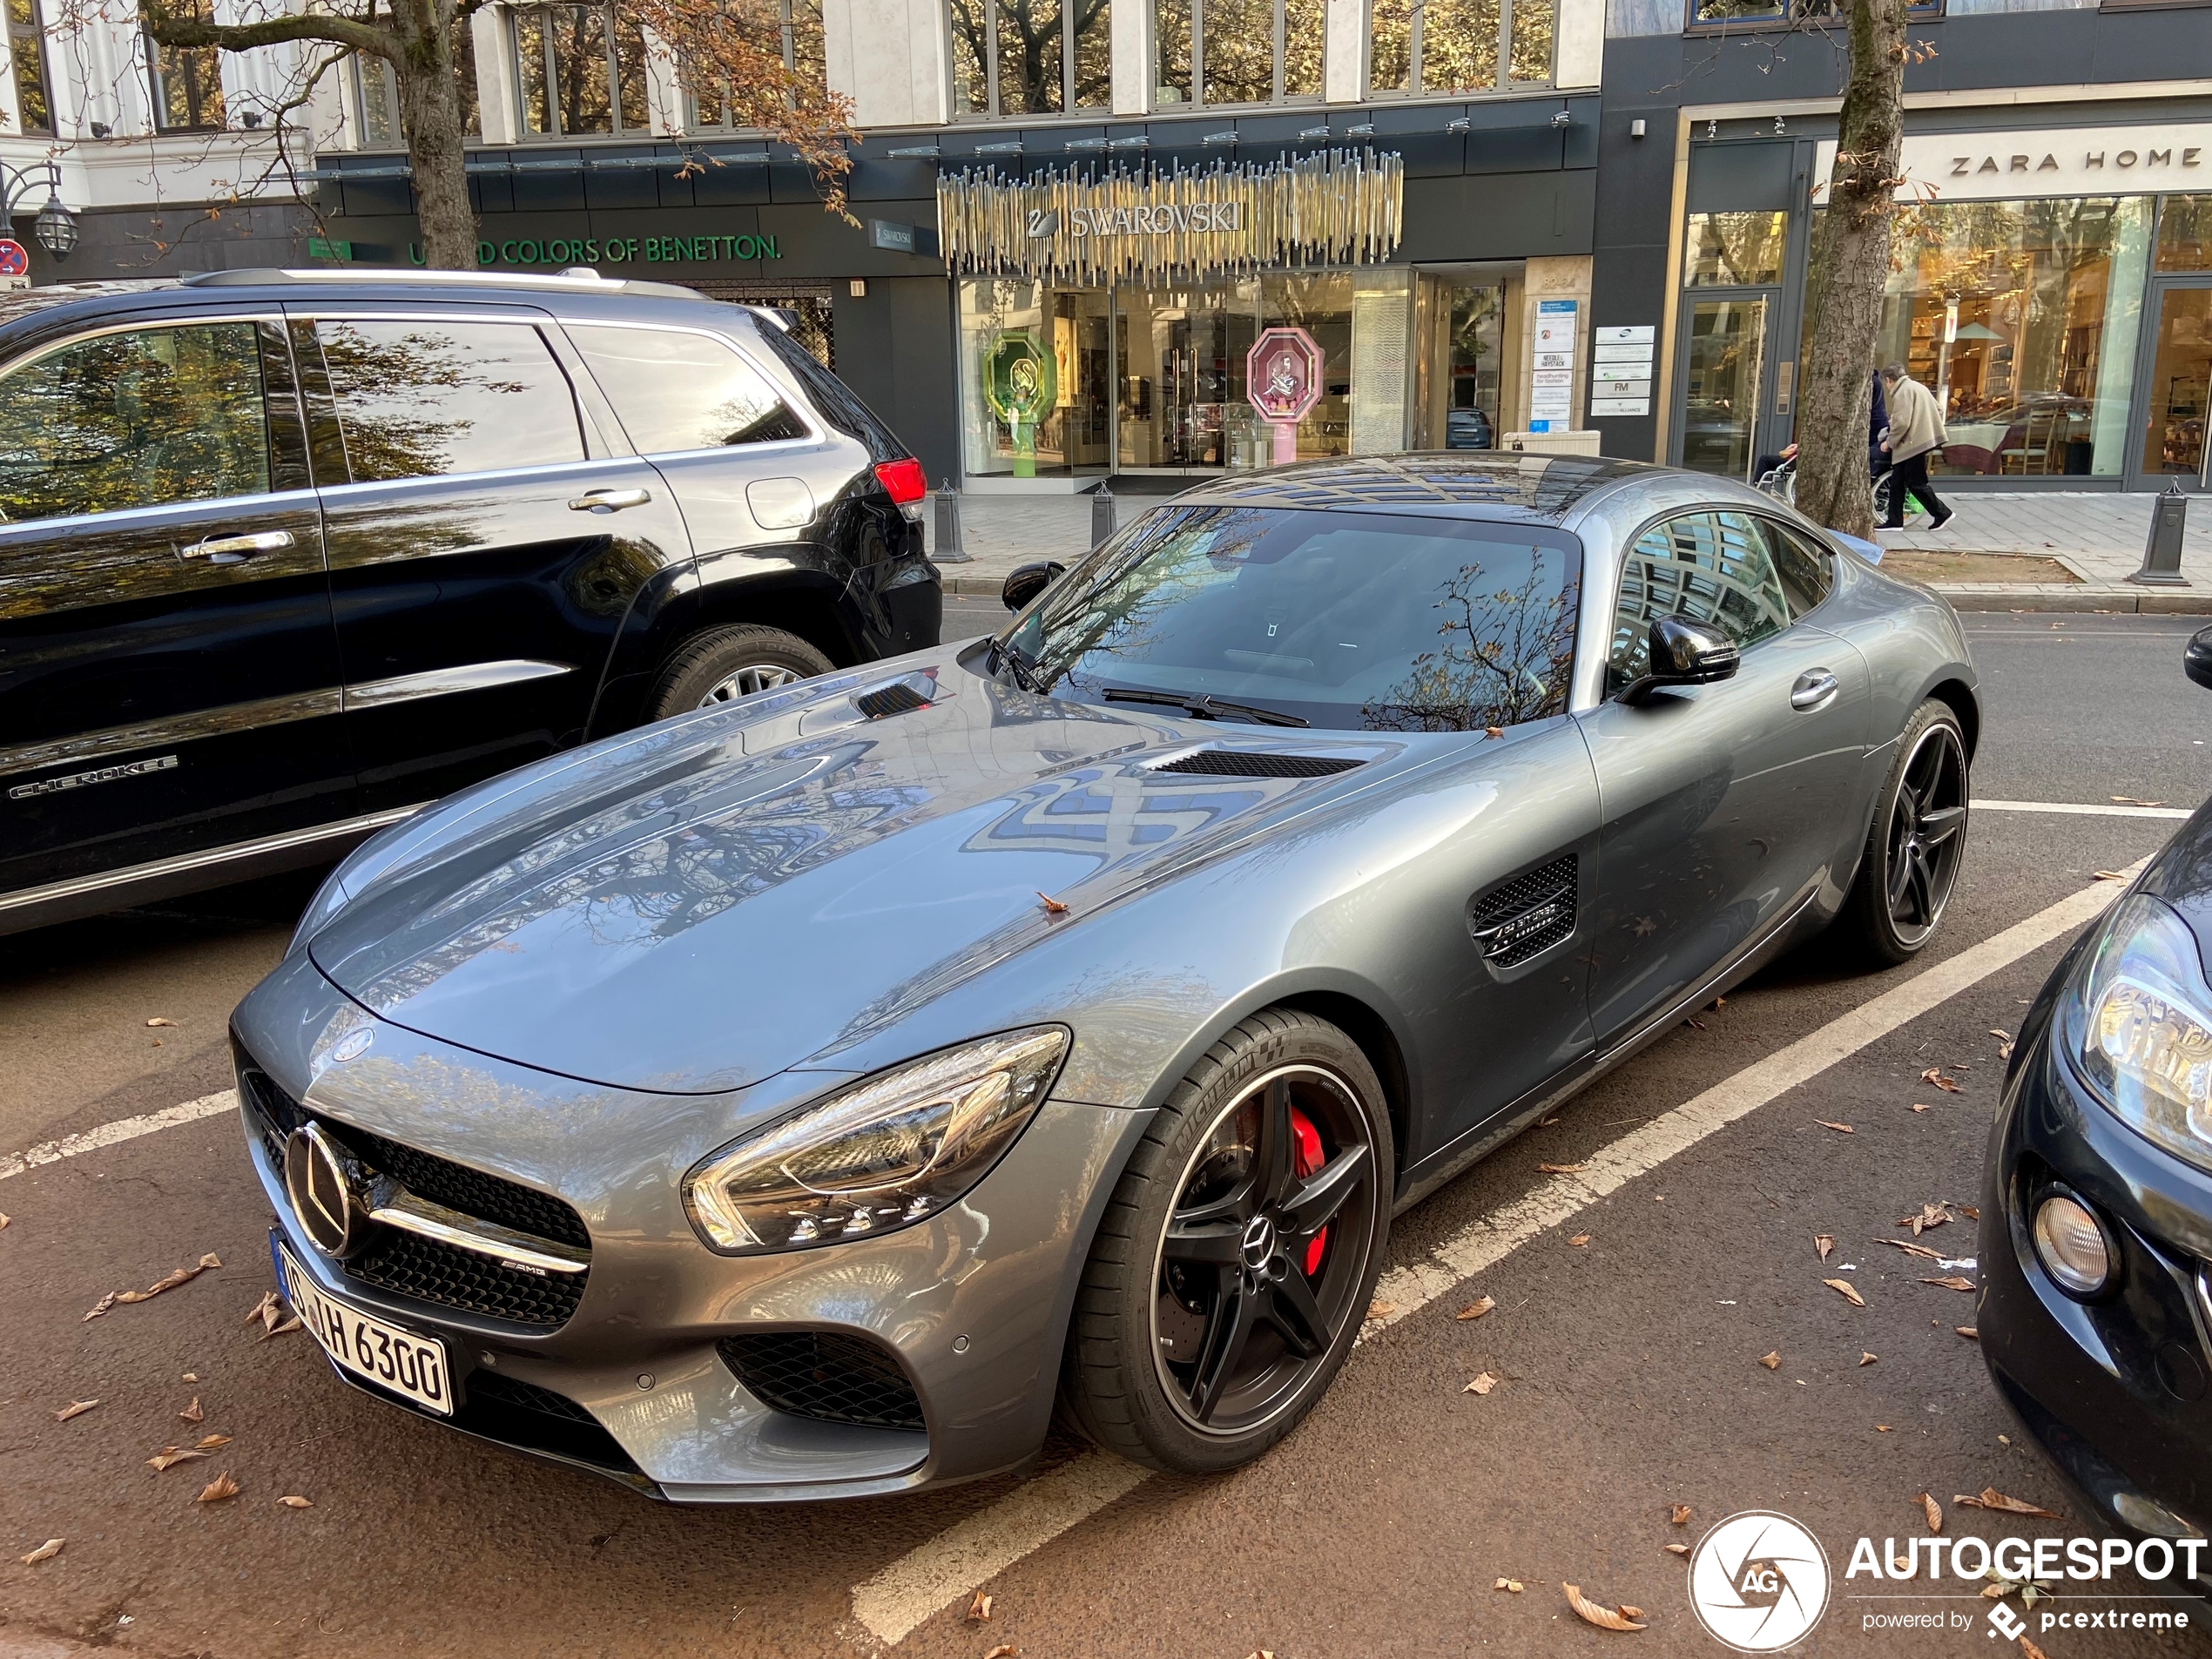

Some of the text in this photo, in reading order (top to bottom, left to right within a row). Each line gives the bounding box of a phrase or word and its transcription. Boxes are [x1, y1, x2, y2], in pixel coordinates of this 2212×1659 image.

[1951, 147, 2202, 175] ZARA HOME
[1070, 201, 1240, 239] SWAROVSKI
[502, 238, 600, 265] COLORS
[605, 237, 638, 263] OF
[1615, 382, 1629, 391] FM
[10, 754, 179, 799] CHEROKEE
[1175, 1051, 1258, 1155] MICHELIN
[516, 1263, 546, 1277] AMG
[355, 1321, 442, 1401] 6300
